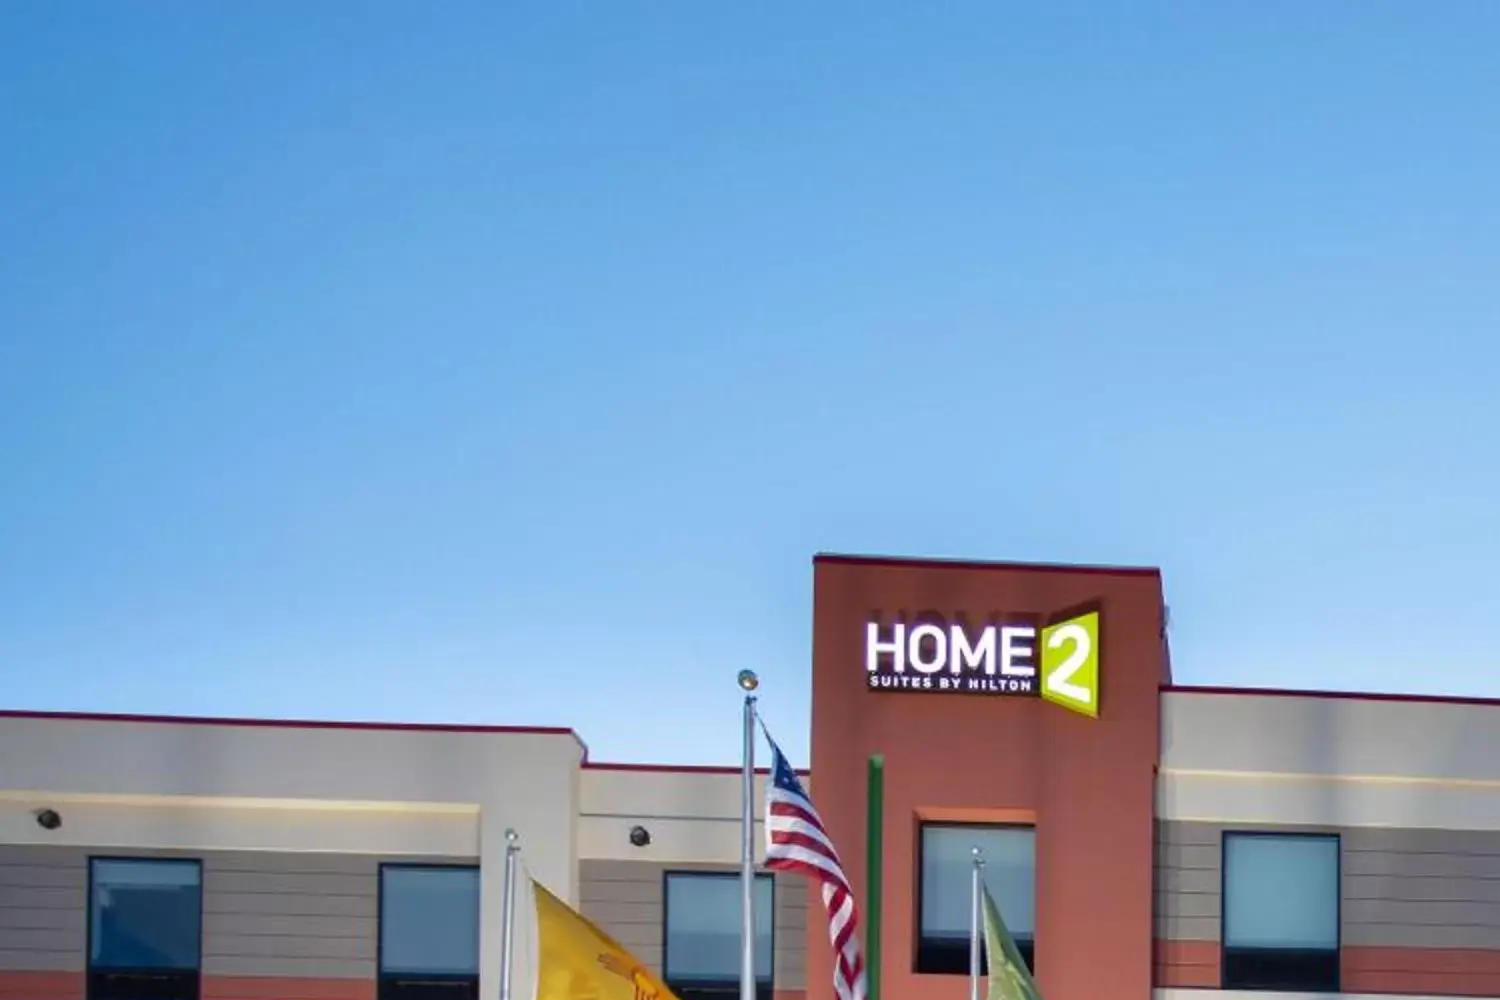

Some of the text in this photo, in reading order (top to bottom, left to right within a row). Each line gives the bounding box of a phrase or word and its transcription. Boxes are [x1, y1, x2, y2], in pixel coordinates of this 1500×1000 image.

[867, 622, 1091, 704] HOME 2
[869, 676, 1031, 691] SUITES BY HILTON
